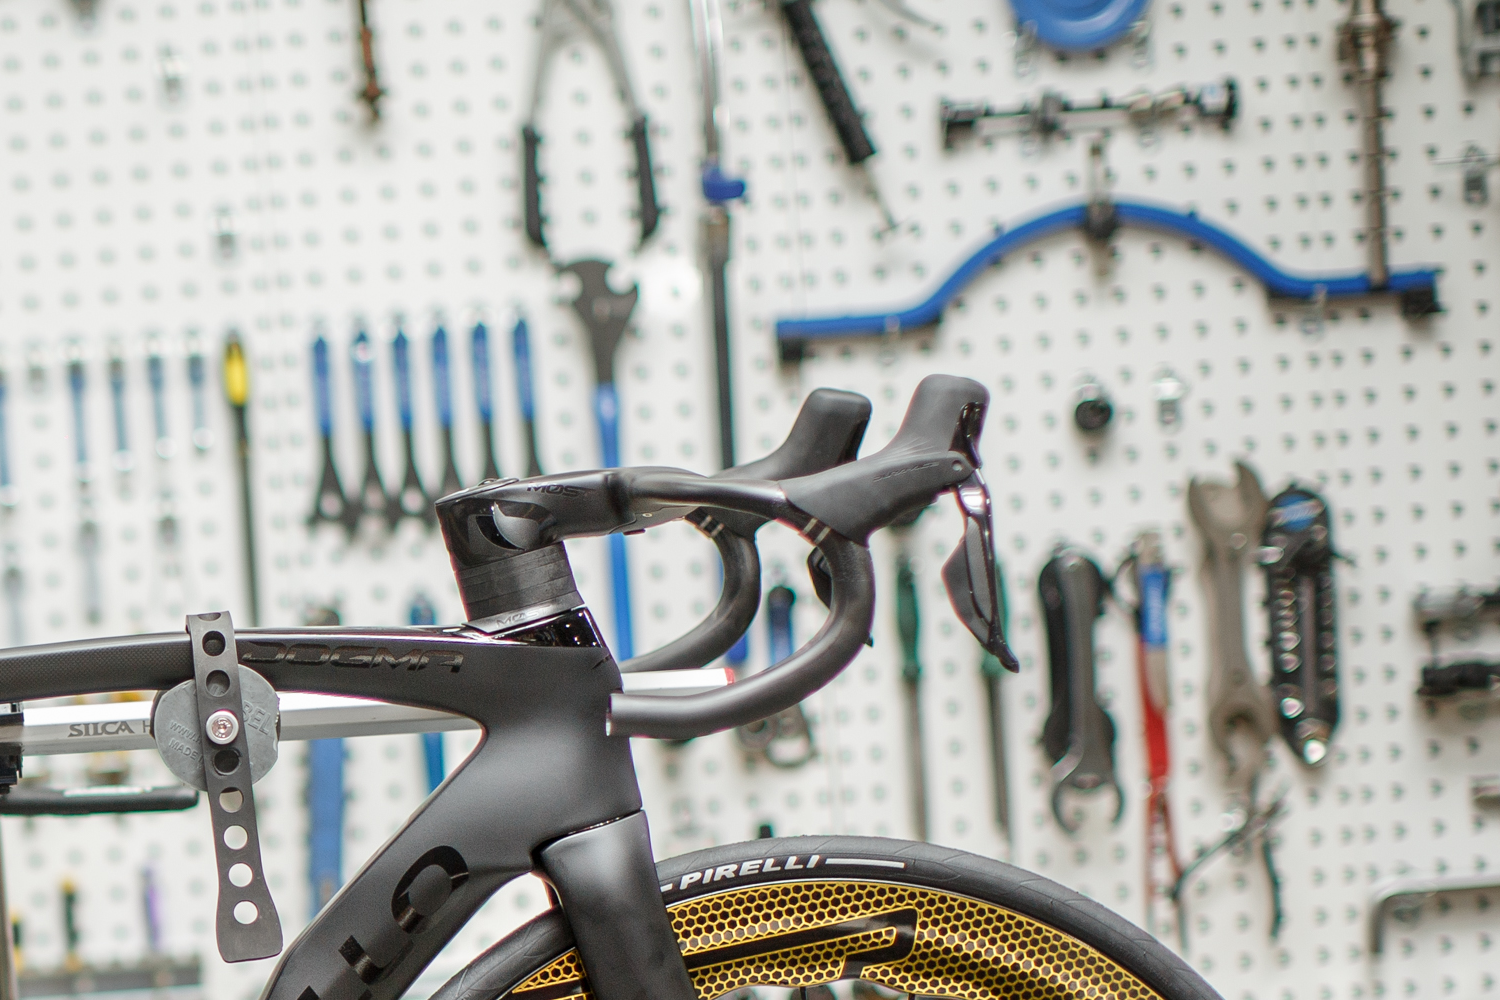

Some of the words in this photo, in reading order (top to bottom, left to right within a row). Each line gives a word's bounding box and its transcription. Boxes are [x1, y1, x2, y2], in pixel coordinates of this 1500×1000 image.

[242, 641, 464, 673] DOGMA
[67, 720, 135, 738] SILCA
[679, 854, 820, 891] PIRELLI
